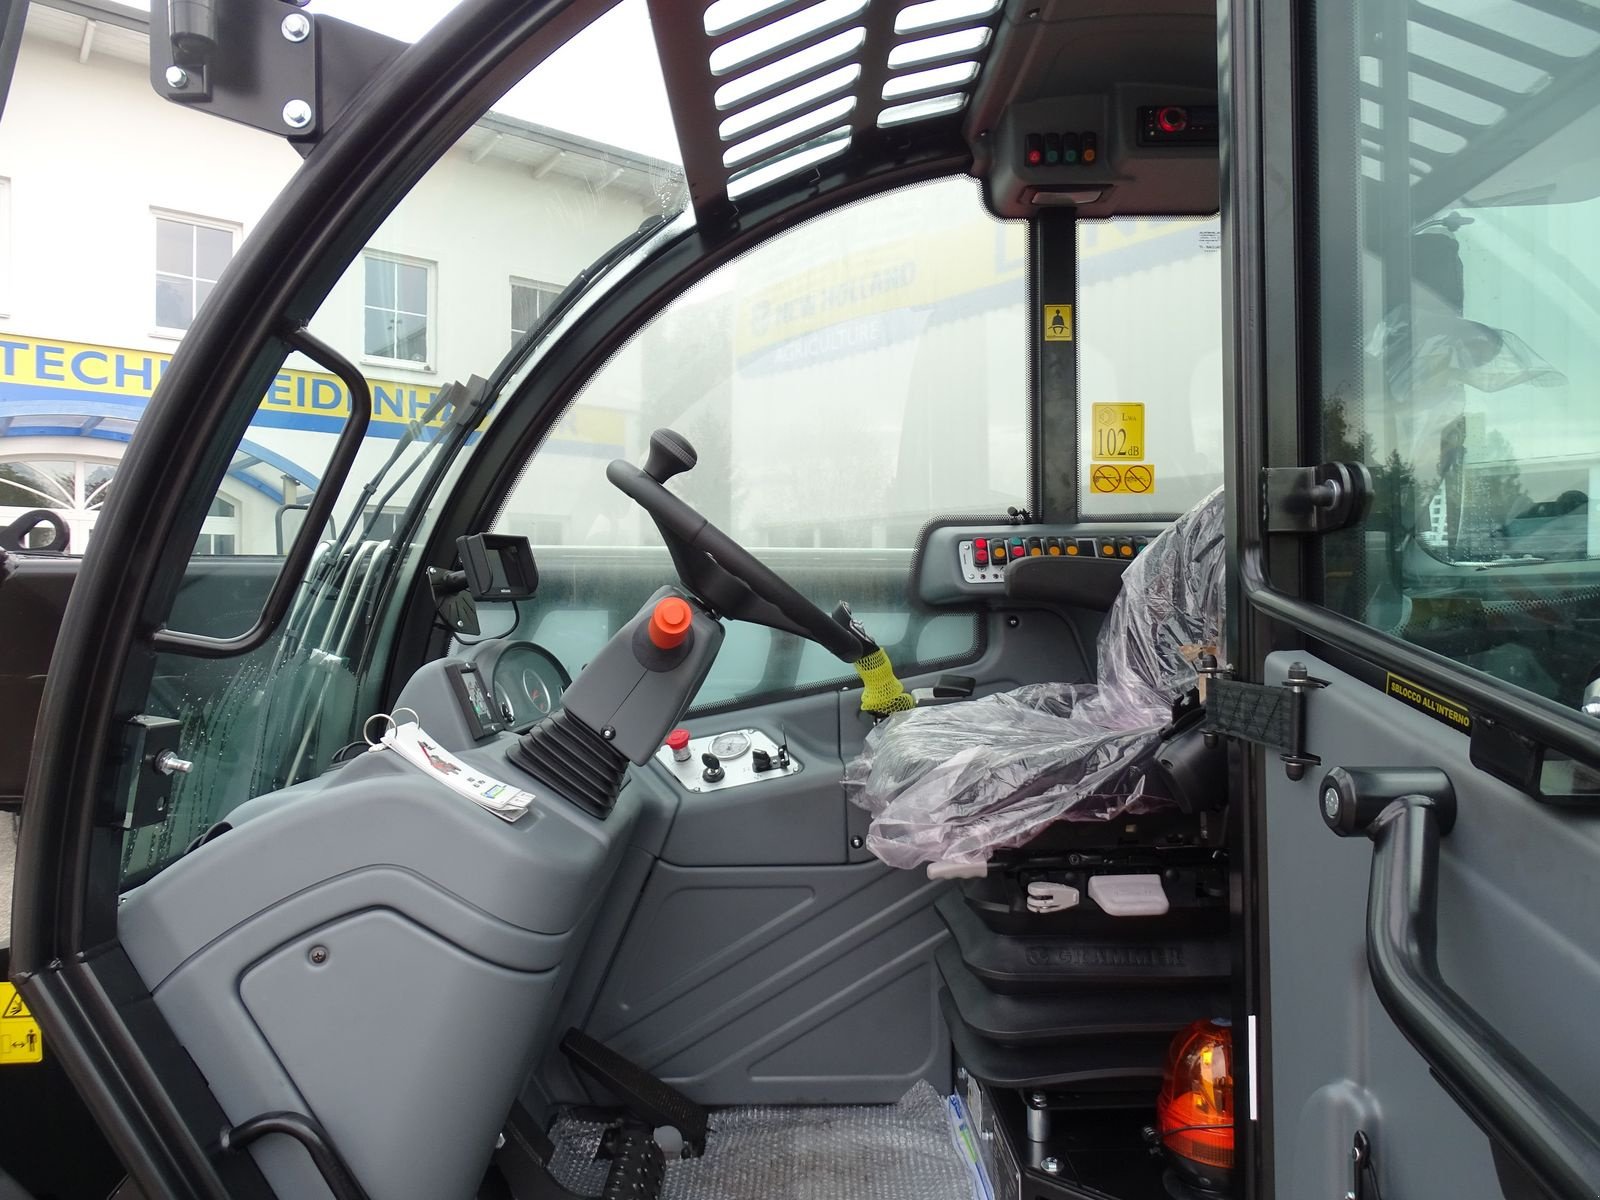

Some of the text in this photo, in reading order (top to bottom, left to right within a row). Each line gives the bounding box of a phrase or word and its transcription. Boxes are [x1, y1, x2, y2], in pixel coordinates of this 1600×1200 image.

[0, 340, 168, 391] TECH
[1097, 427, 1140, 456] 102 dB
[1391, 681, 1470, 727] SBLOCCO ALL'INTERNO
